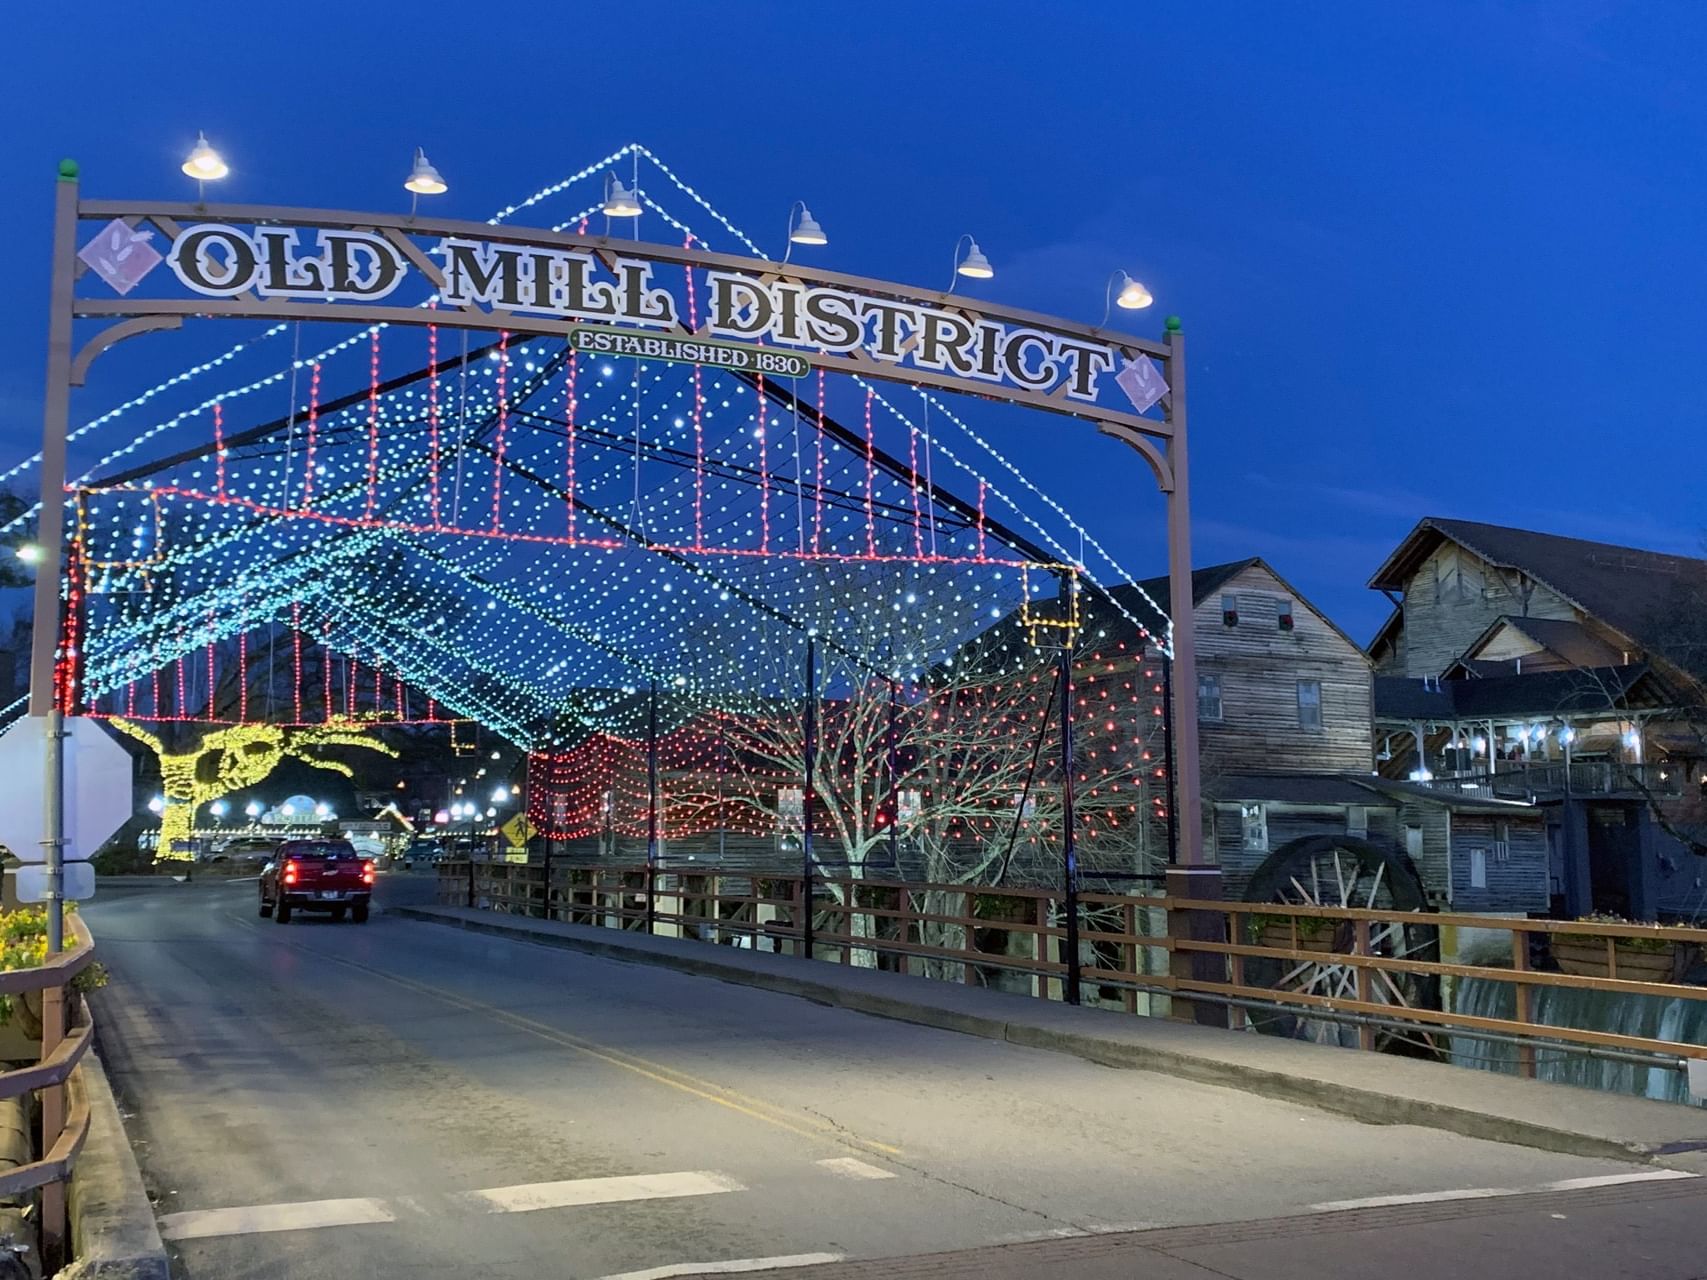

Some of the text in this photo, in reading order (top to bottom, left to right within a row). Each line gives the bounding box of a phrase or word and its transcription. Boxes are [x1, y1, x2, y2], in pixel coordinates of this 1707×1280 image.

[166, 223, 1115, 401] OLD MILL DISTRICT
[578, 331, 801, 374] ESTABLISHED 1830
